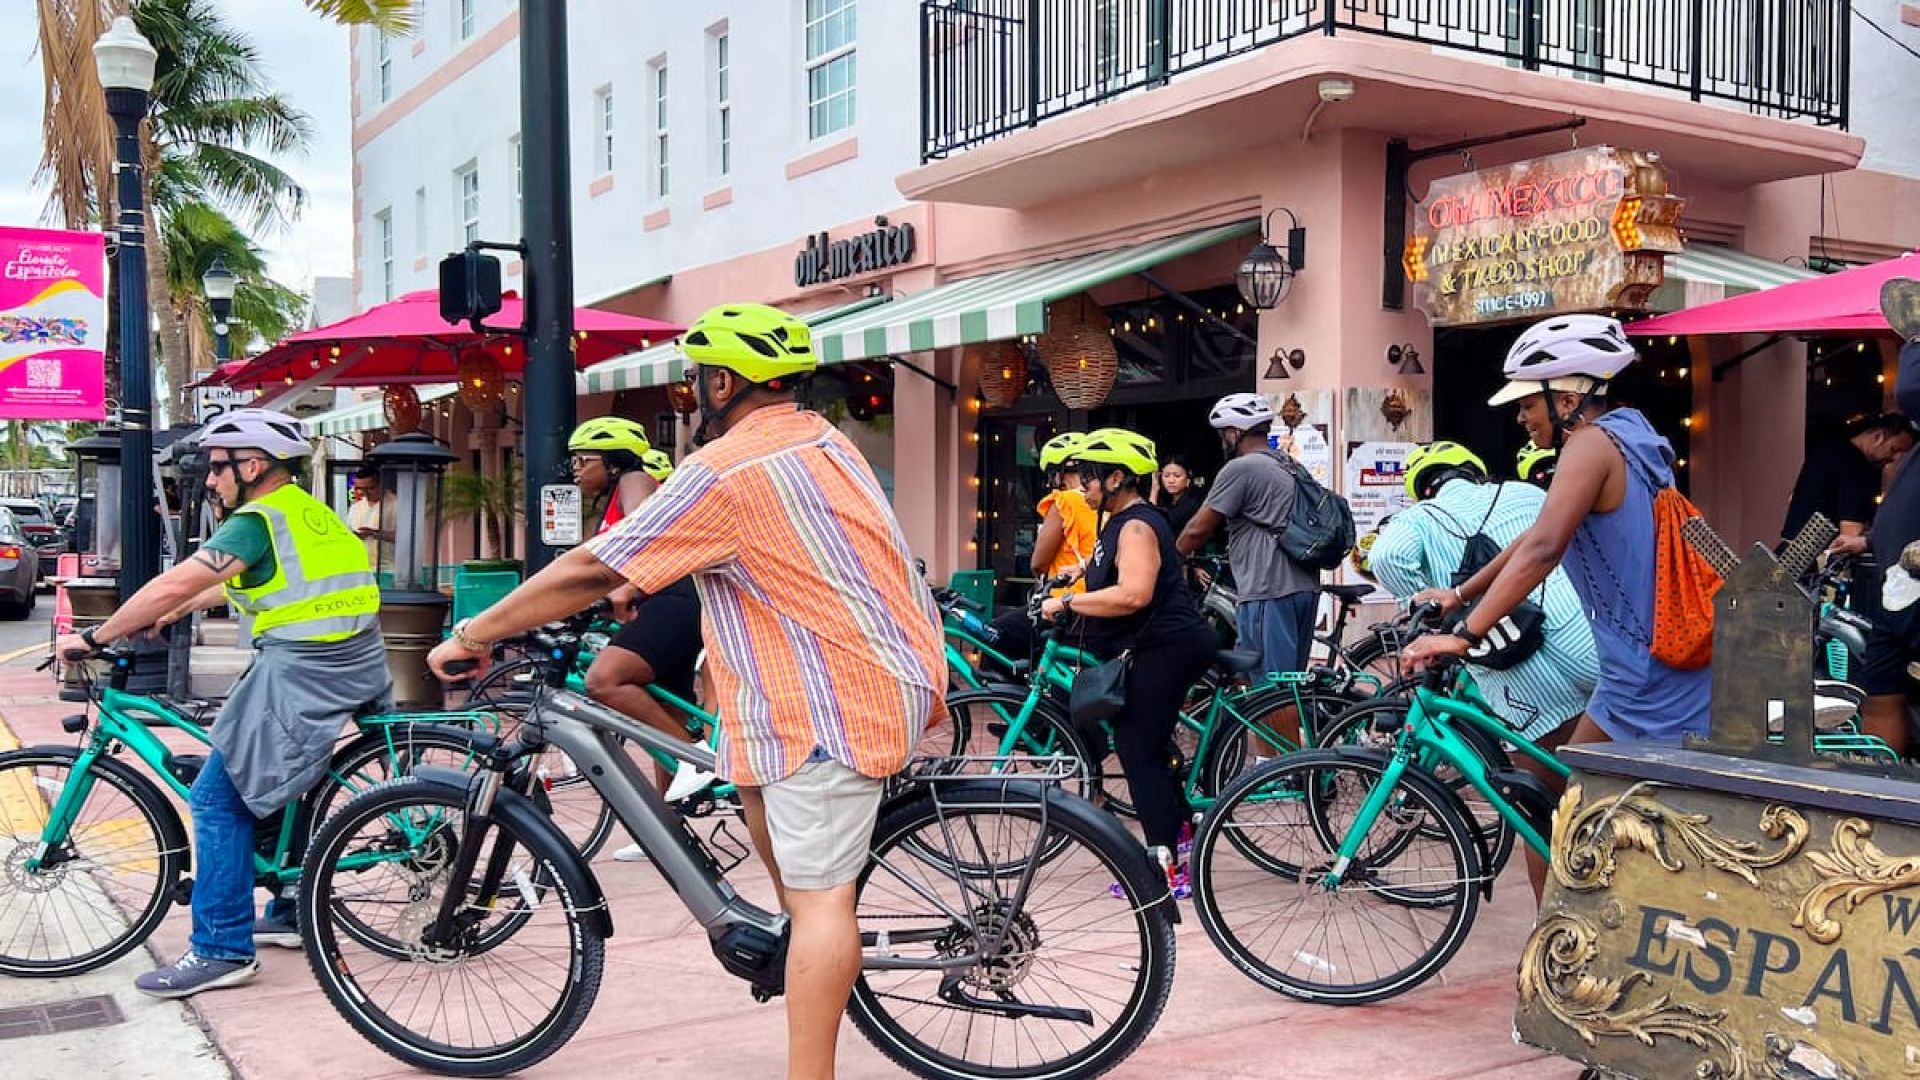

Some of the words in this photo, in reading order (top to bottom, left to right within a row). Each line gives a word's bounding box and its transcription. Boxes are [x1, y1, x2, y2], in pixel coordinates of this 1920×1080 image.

[1487, 169, 1616, 216] MEXICO
[1431, 228, 1533, 265] MEXICAN
[1536, 217, 1602, 246] FOOD
[1440, 273, 1457, 294] &
[1459, 260, 1518, 289] TACO
[1525, 251, 1586, 281] SHOP
